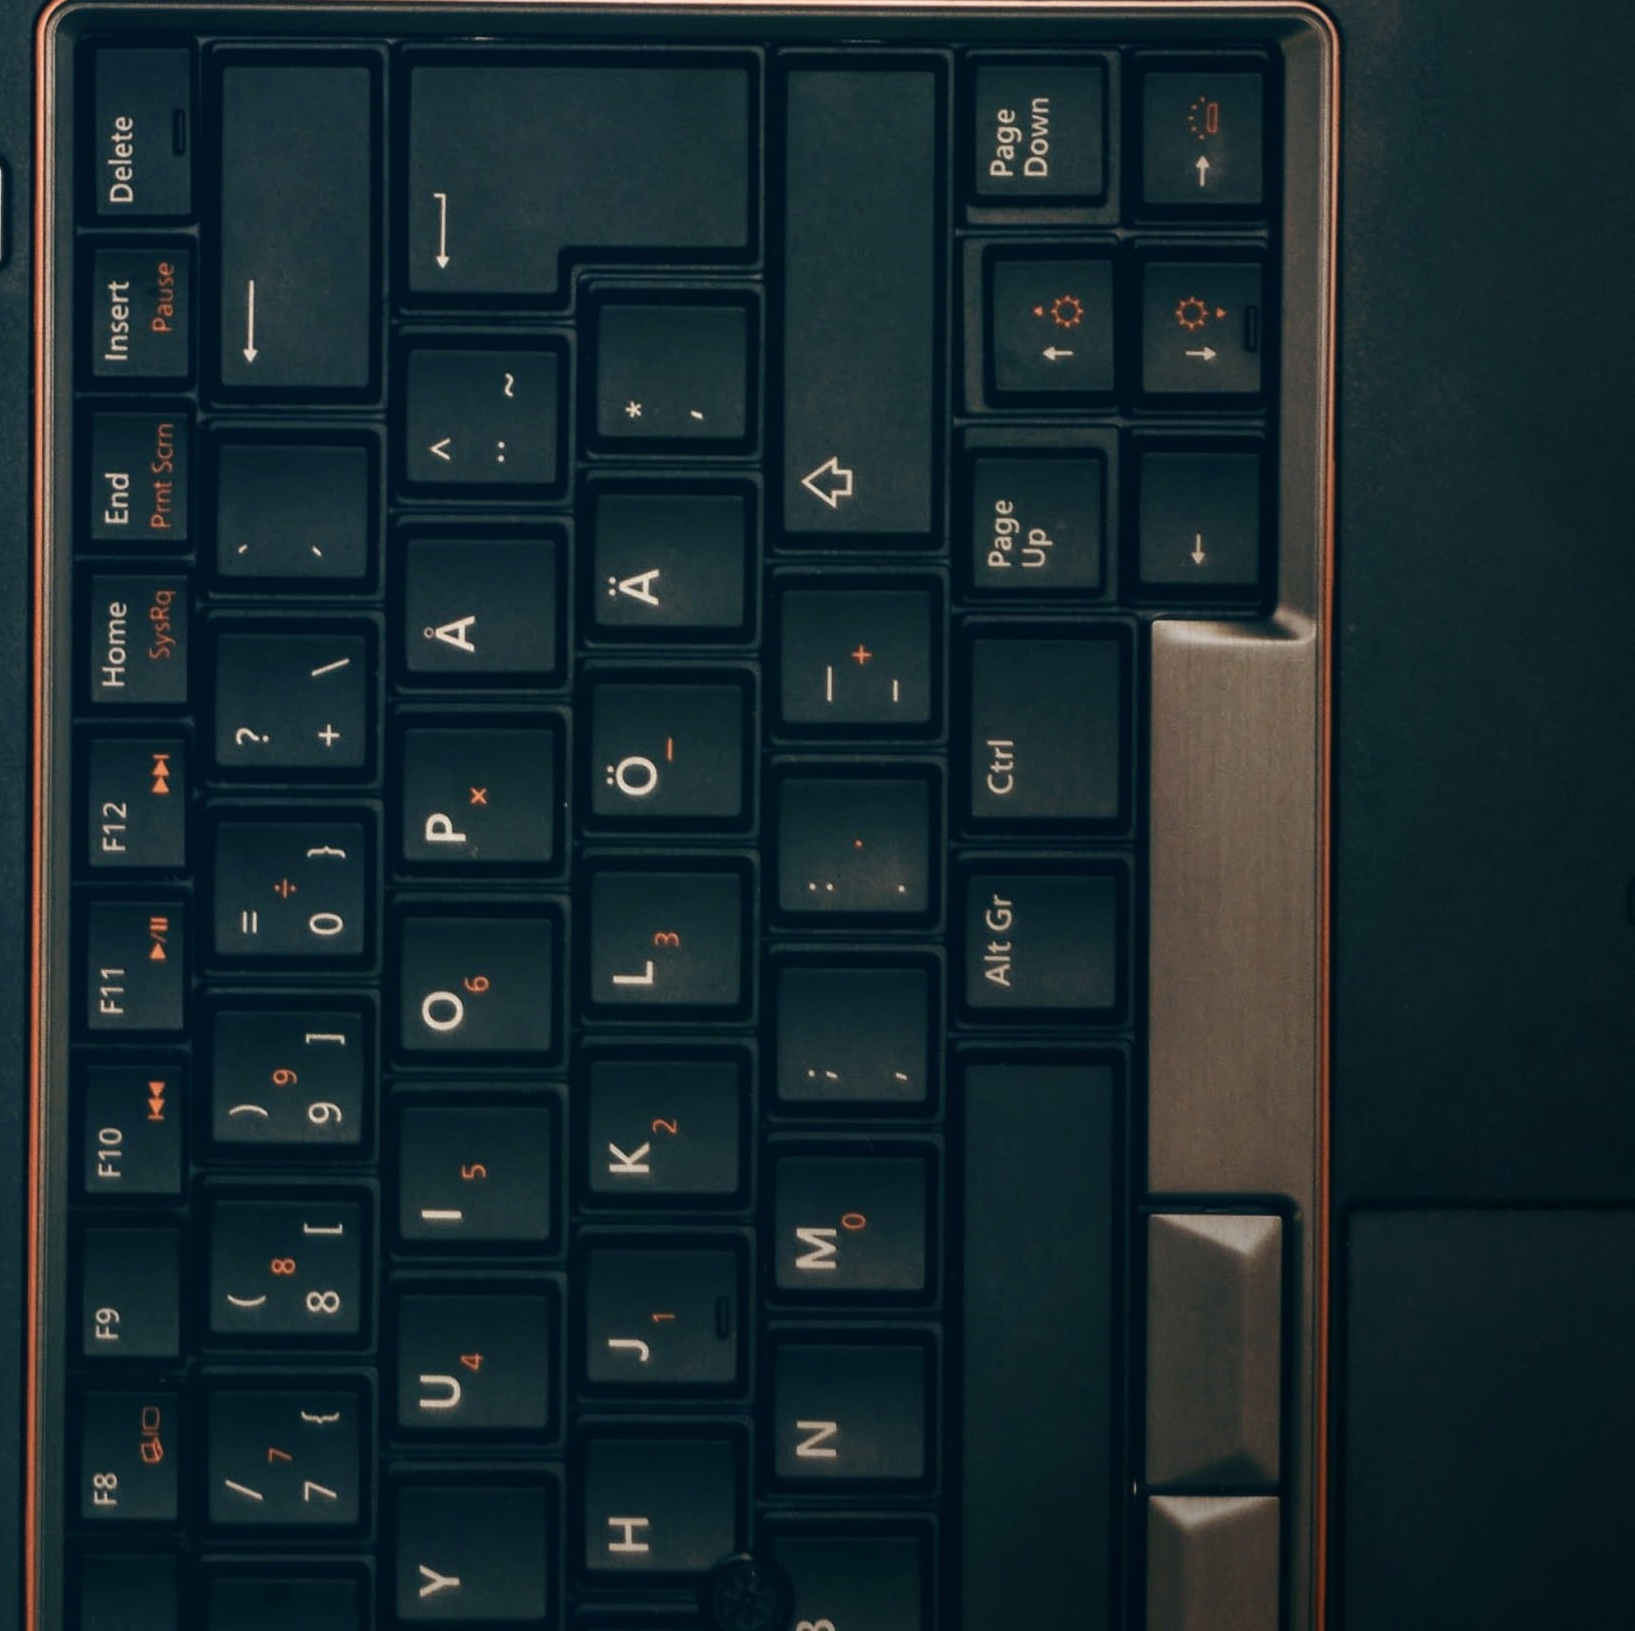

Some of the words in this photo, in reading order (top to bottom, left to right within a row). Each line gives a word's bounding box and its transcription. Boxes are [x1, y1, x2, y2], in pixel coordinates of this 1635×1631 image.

[990, 110, 1021, 176] Page
[1024, 98, 1049, 176] Down
[108, 117, 133, 202] Delete
[152, 263, 173, 332] Pause
[105, 282, 129, 360] Insert
[152, 424, 173, 473] Scrn
[105, 474, 129, 523] End
[151, 482, 171, 528] Prnt
[988, 501, 1019, 567] Page
[1022, 529, 1052, 567] Up
[609, 570, 659, 605] Ä
[149, 591, 175, 658] SysRq
[424, 616, 474, 652] Å
[102, 602, 126, 686] Home
[607, 757, 657, 795] Ö
[987, 741, 1013, 794] Ctrl
[103, 803, 126, 851] F12
[426, 814, 466, 841] P
[310, 913, 343, 935] 0
[986, 895, 1011, 930] Gr
[613, 961, 653, 984] L
[984, 942, 1010, 986] Alt
[100, 969, 124, 1013] F11
[422, 992, 463, 1031] O
[308, 1103, 341, 1124] 9
[98, 1129, 122, 1177] F10
[610, 1143, 649, 1173] K
[422, 1210, 461, 1219] I
[796, 1228, 836, 1269] M
[306, 1291, 340, 1313] 8
[96, 1309, 119, 1339] F9
[609, 1339, 649, 1361] J
[420, 1375, 460, 1408] U
[797, 1422, 837, 1457] N
[94, 1474, 117, 1505] F8
[305, 1482, 336, 1501] 7
[609, 1518, 648, 1552] H
[420, 1566, 459, 1597] Y
